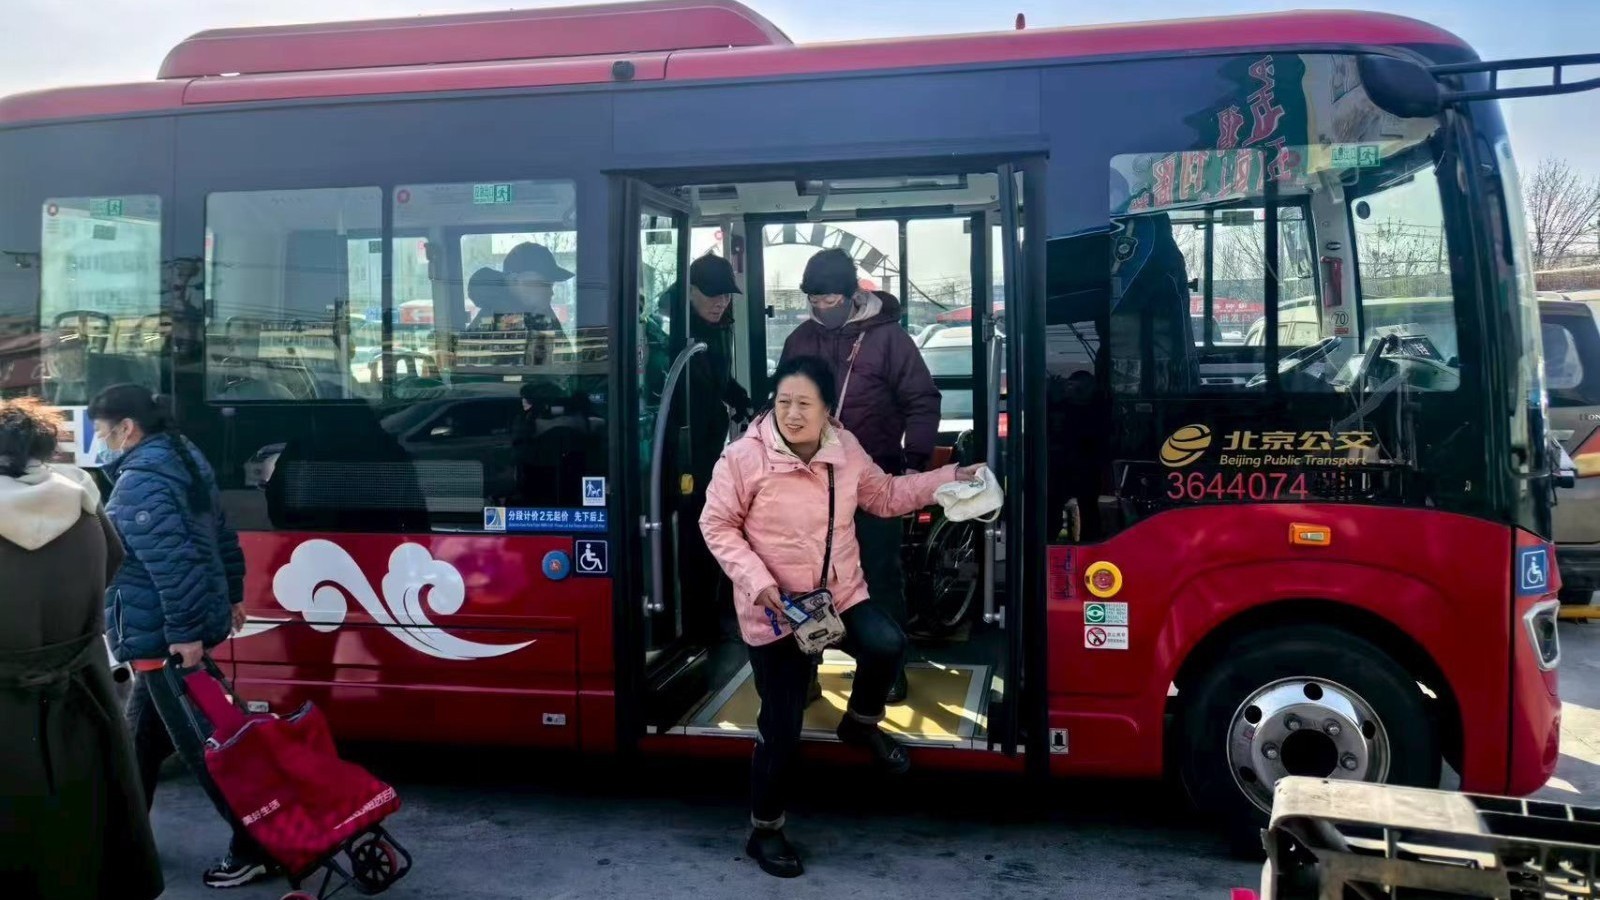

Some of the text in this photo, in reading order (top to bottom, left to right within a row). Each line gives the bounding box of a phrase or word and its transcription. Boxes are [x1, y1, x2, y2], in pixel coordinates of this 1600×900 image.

[1334, 313, 1346, 324] 70
[1222, 430, 1373, 450] 北京公交
[1219, 454, 1368, 467] Beijing Public Transport
[1166, 471, 1309, 499] 3644074
[508, 510, 605, 522] 分段计价2元起价 先下后上
